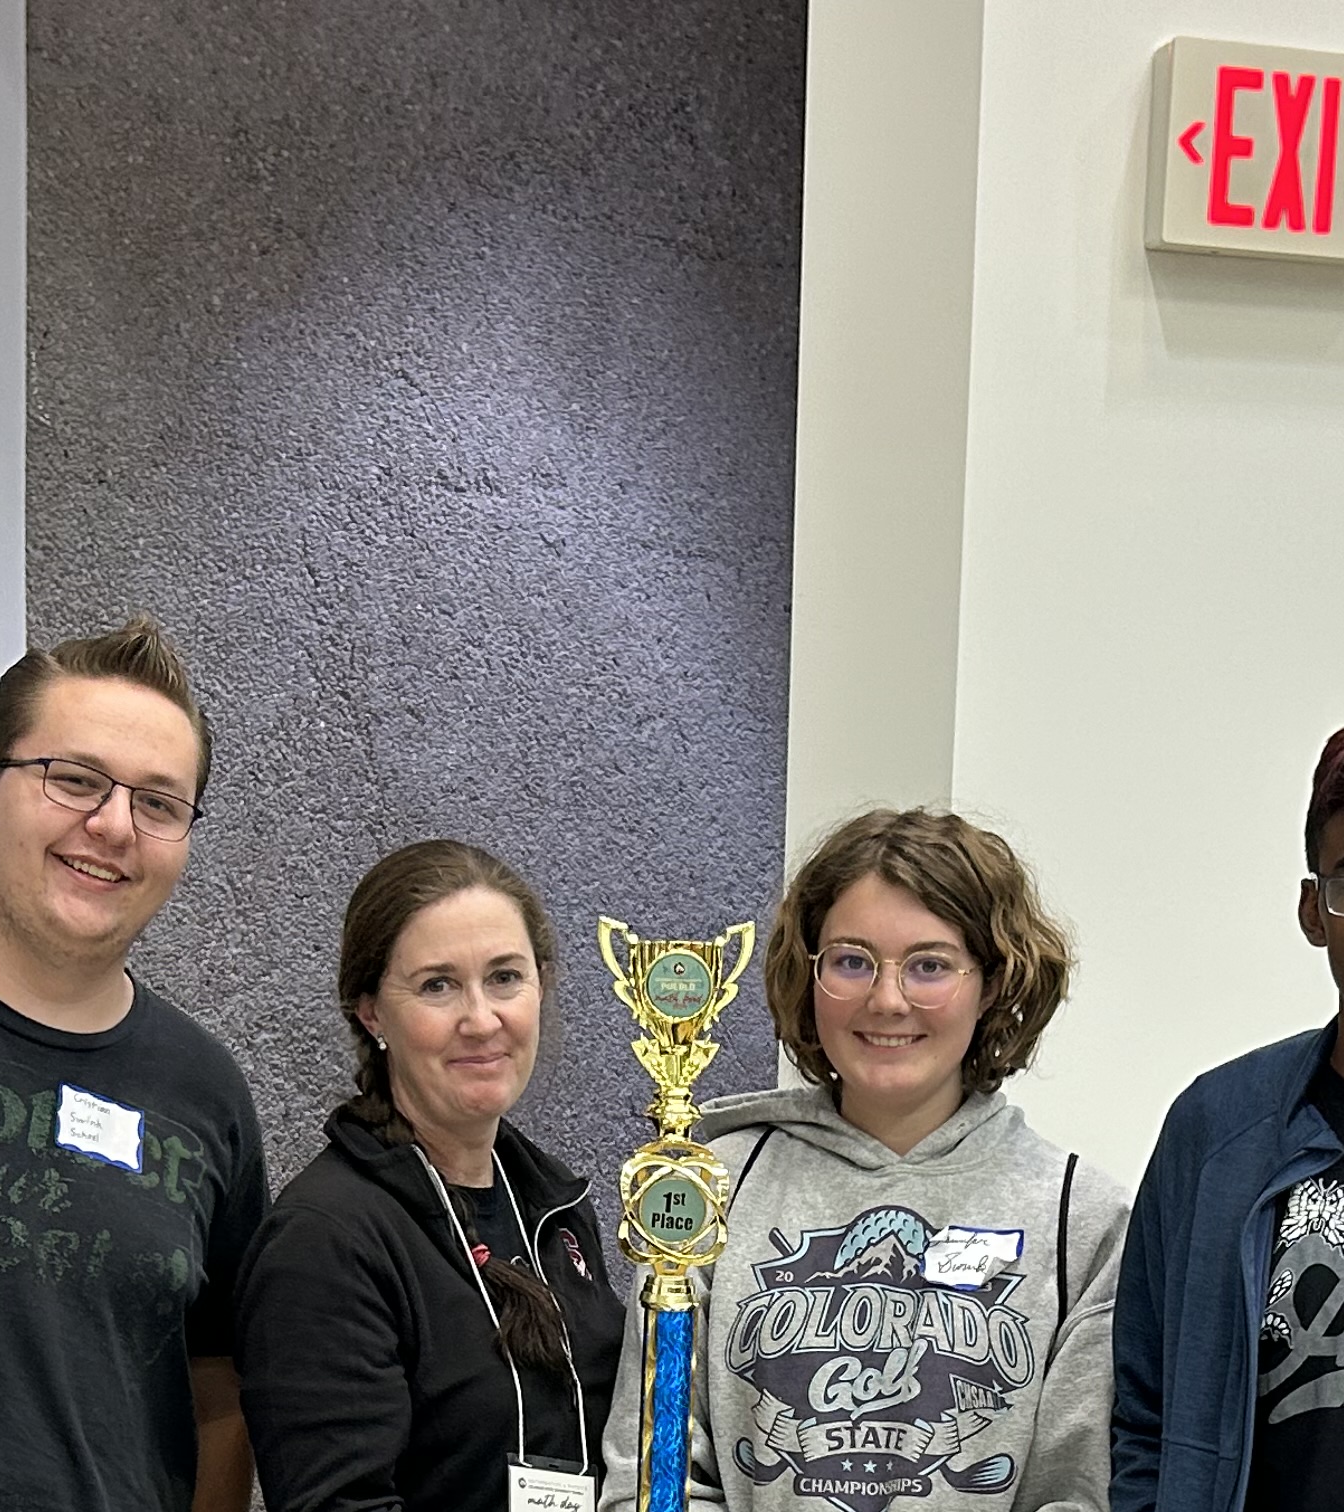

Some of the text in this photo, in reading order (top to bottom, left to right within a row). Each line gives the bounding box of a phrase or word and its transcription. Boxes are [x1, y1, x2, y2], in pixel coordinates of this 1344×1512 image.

[663, 1191, 686, 1213] 1st
[651, 1212, 693, 1230] Place
[775, 1270, 794, 1282] 20
[726, 1283, 1034, 1387] COLORADO
[808, 1339, 929, 1420] Golf
[825, 1426, 907, 1451] STATE
[799, 1477, 923, 1496] CHAMPIONSHIPS
[528, 1494, 558, 1509] math
